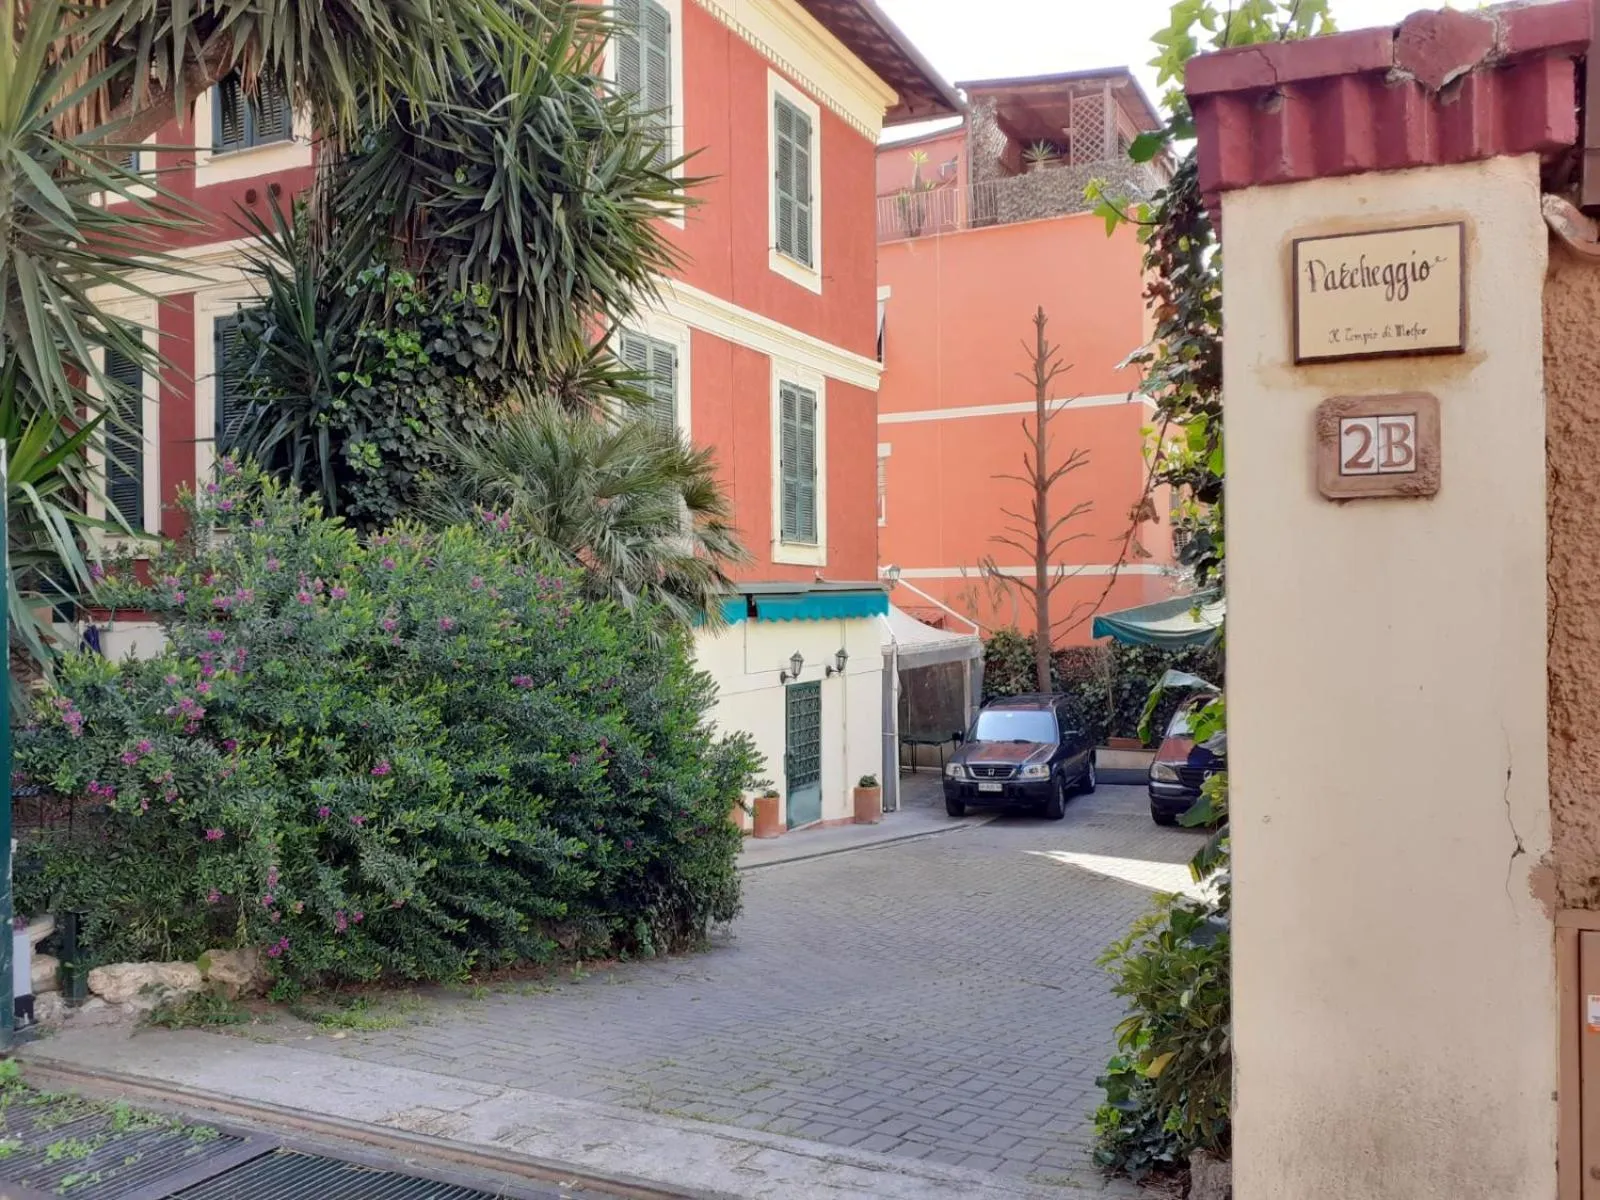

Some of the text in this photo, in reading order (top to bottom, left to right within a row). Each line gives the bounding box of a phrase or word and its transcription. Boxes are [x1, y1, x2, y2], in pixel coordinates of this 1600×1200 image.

[1304, 250, 1447, 301] Parcheggio
[1382, 323, 1393, 338] di
[1344, 422, 1413, 468] 2B
